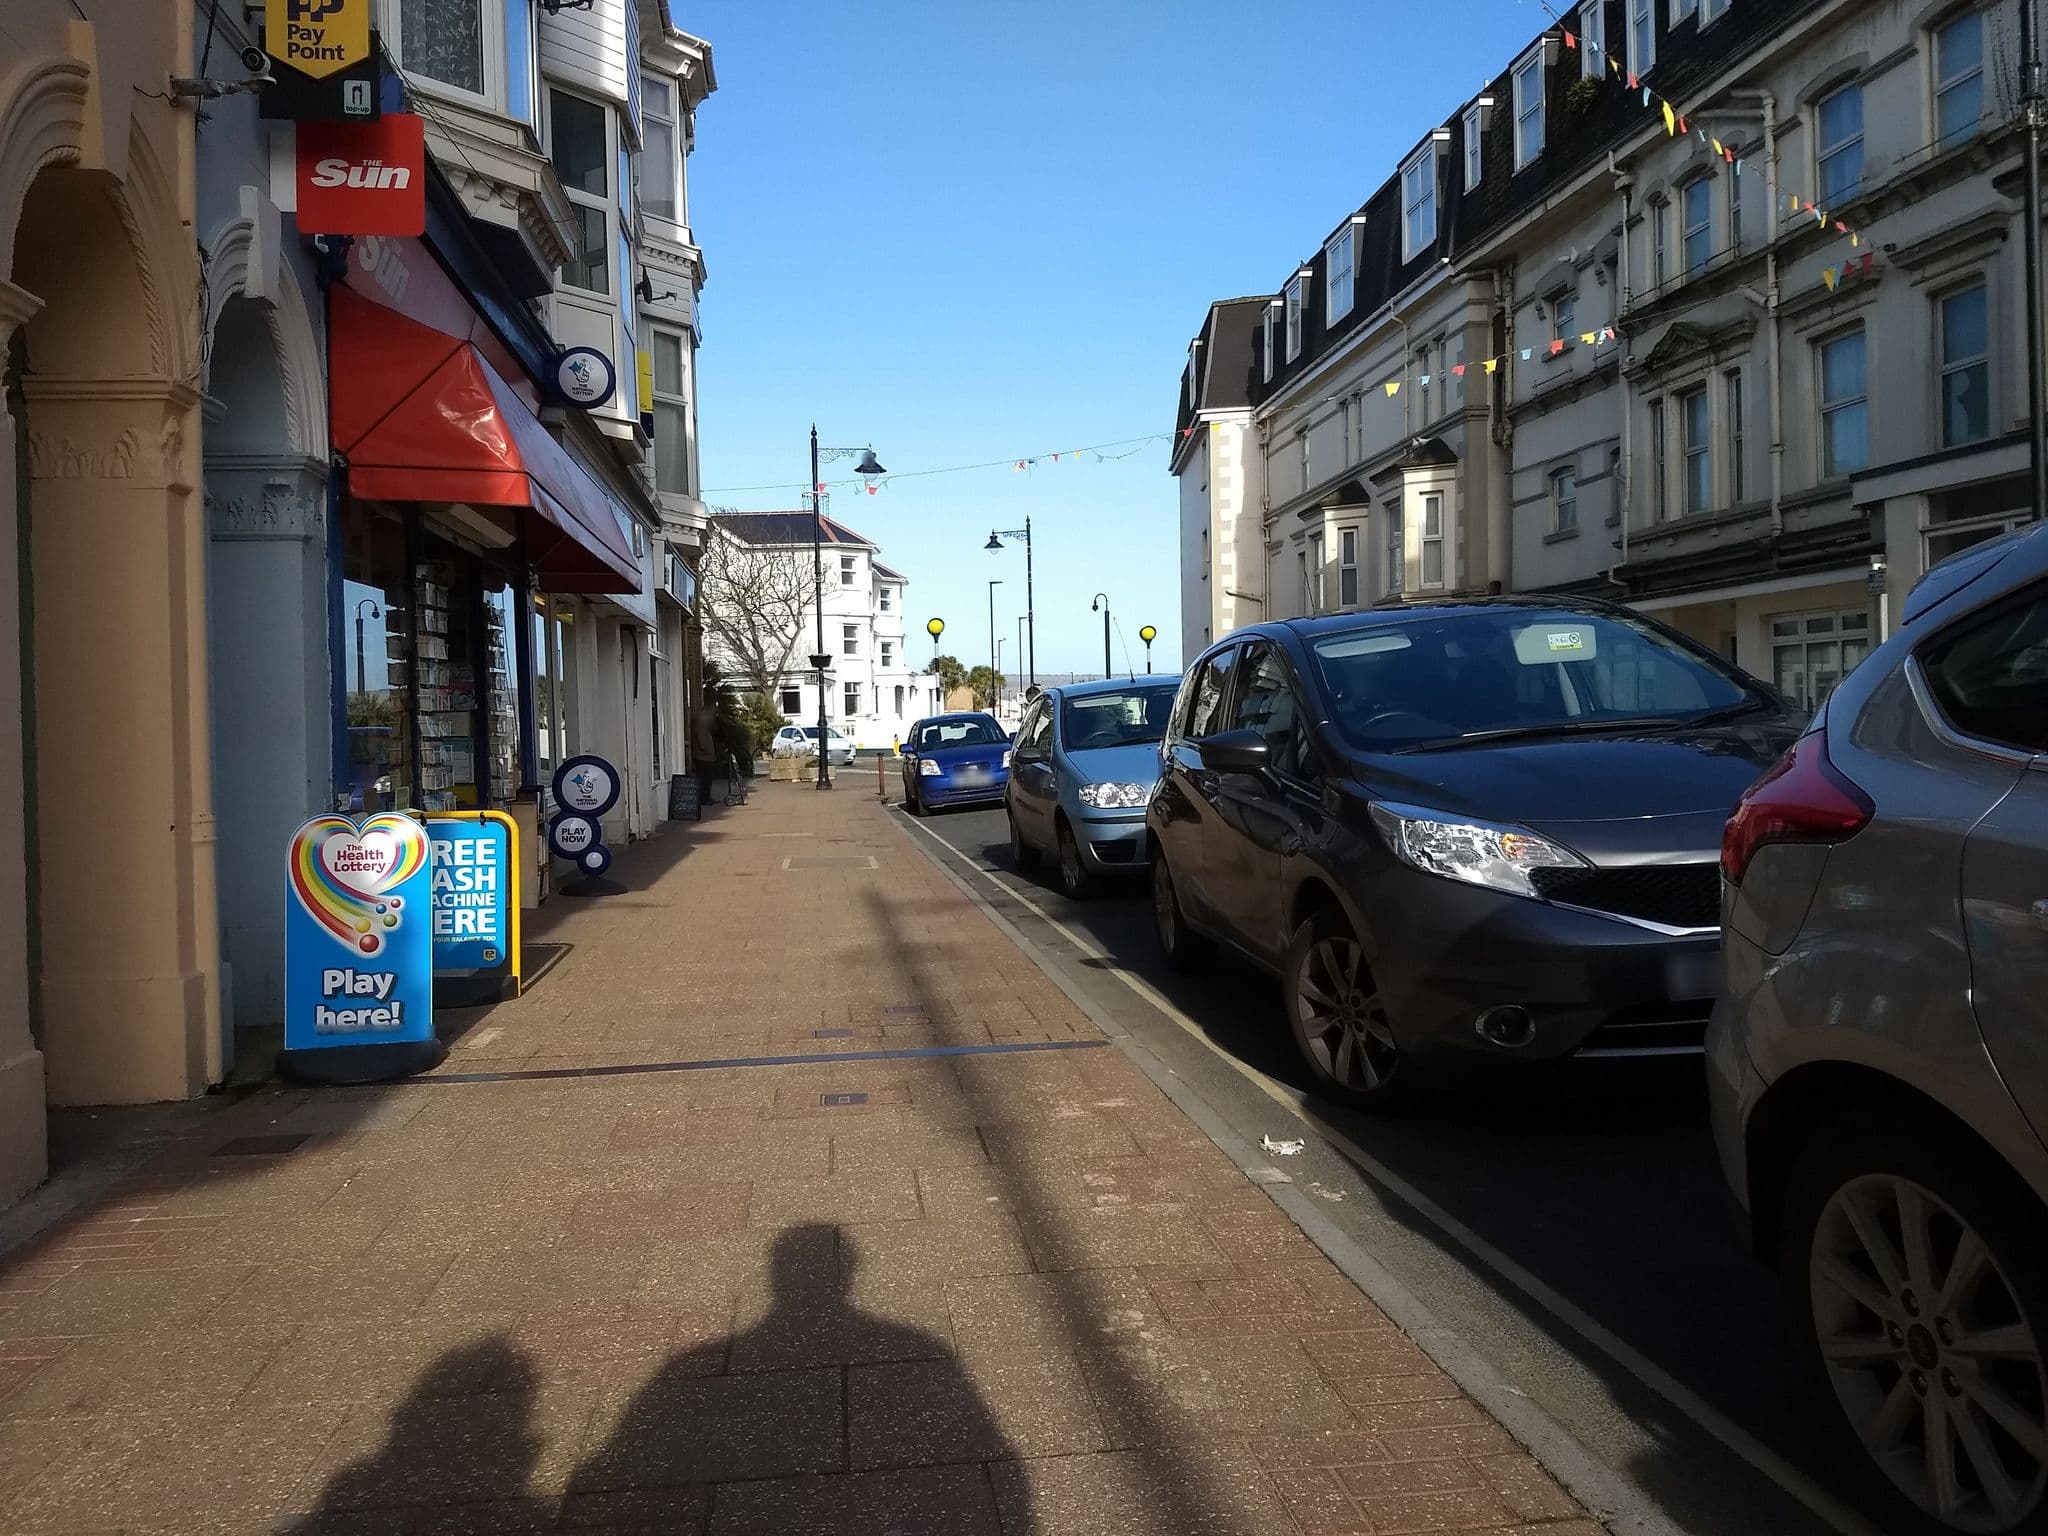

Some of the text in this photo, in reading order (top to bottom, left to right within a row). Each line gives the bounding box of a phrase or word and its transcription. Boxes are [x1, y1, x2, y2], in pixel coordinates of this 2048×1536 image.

[288, 24, 326, 45] Pay
[288, 42, 346, 60] Point
[346, 104, 370, 113] top-up
[311, 158, 411, 189] Sun
[362, 159, 384, 167] THE
[337, 849, 384, 861] Health
[432, 838, 497, 866] REE
[334, 861, 387, 874] Lottery
[432, 867, 497, 892] ASH
[432, 892, 496, 907] ACHINE
[434, 908, 497, 935] ERE
[323, 969, 395, 1000] Play
[316, 1001, 401, 1028] here!
